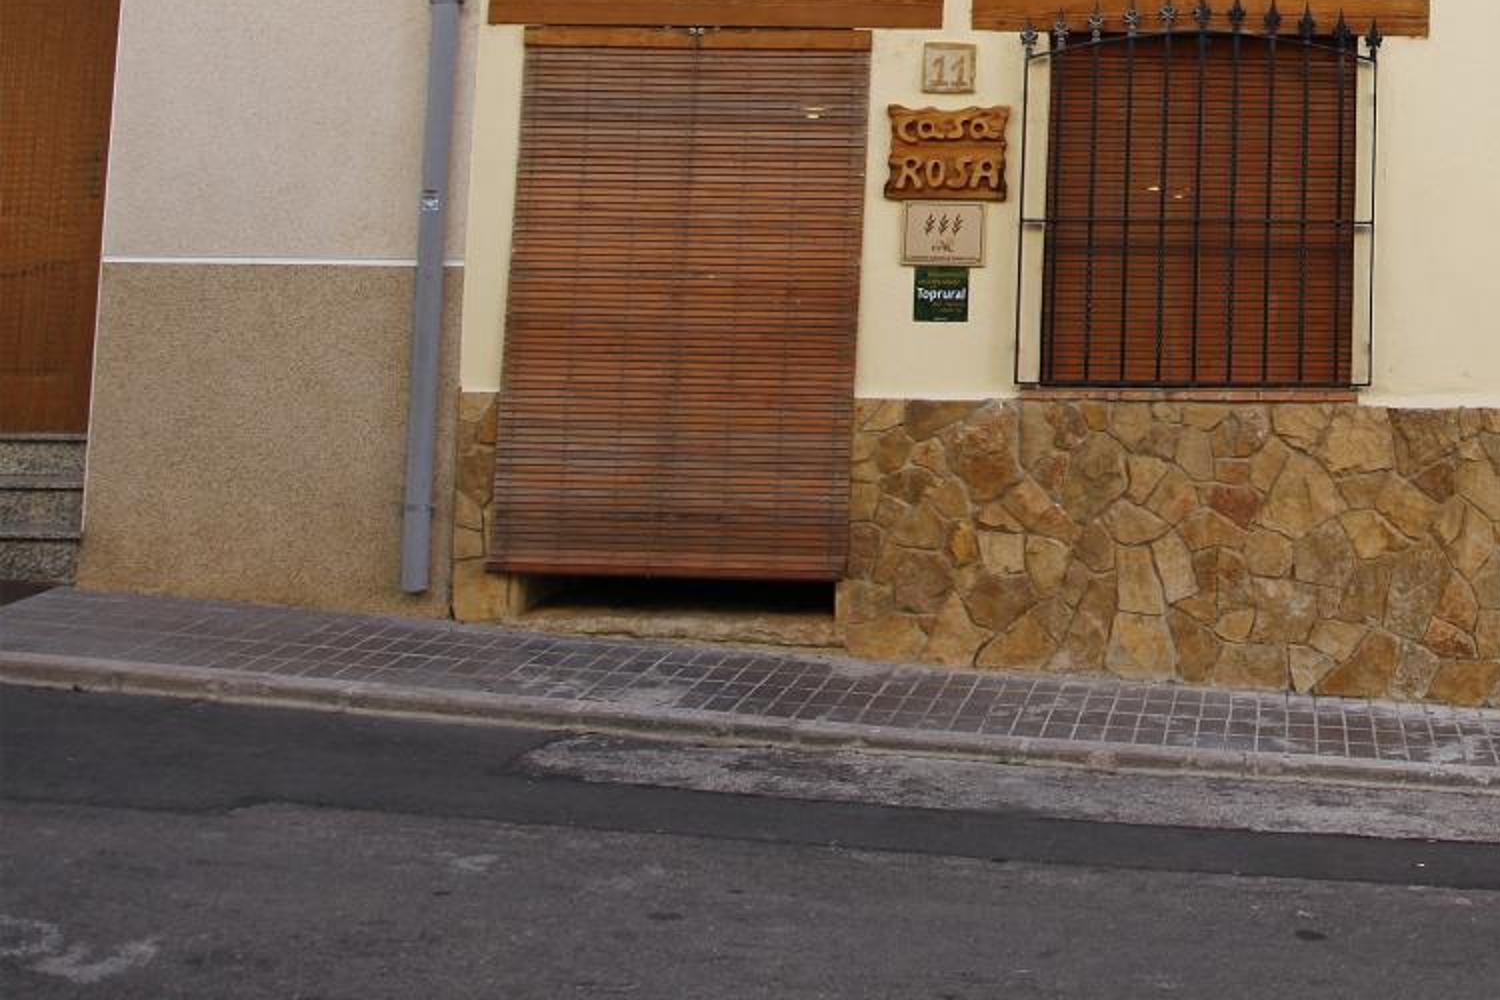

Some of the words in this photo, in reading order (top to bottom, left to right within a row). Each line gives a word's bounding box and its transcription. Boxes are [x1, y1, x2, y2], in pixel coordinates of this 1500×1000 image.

[930, 55, 969, 87] 11
[895, 154, 1000, 189] ROSA
[917, 287, 967, 302] Toprural
